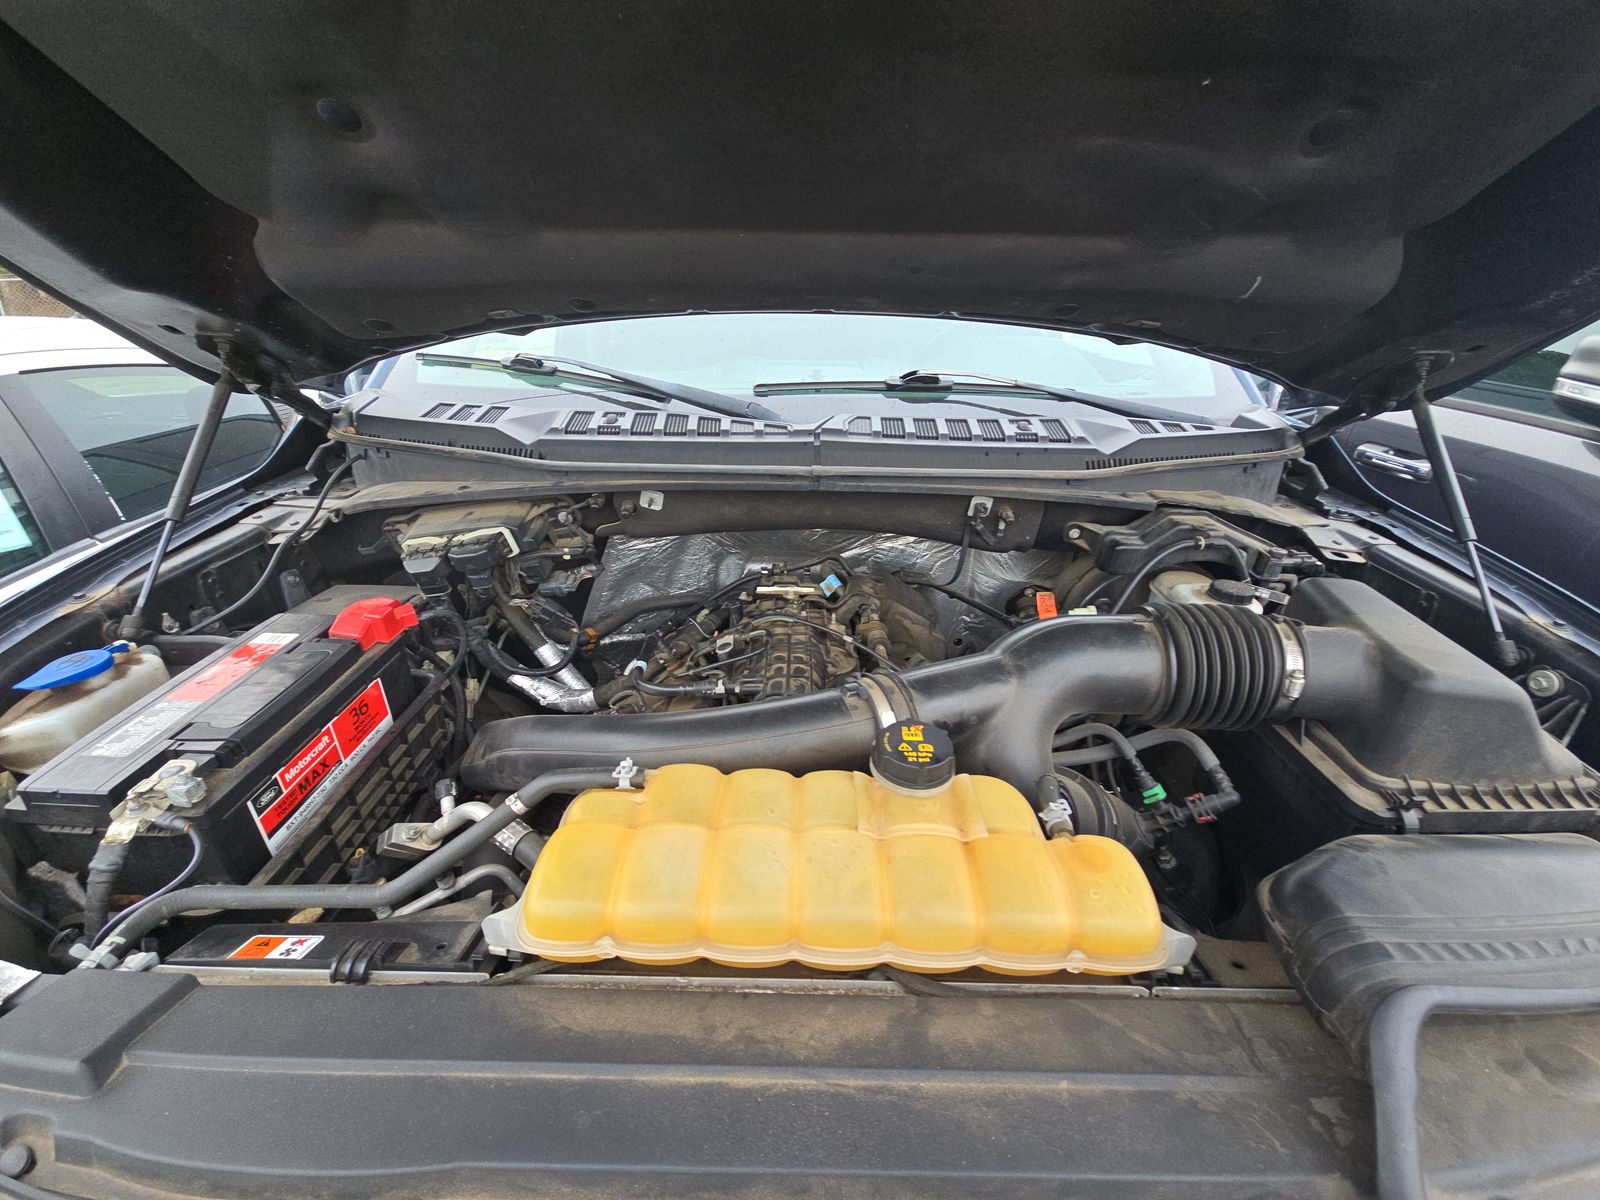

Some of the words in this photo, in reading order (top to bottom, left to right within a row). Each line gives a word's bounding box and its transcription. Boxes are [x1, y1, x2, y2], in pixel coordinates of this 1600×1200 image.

[349, 699, 369, 726] 36
[284, 734, 331, 782] Motorcraft
[297, 758, 329, 795] MAX
